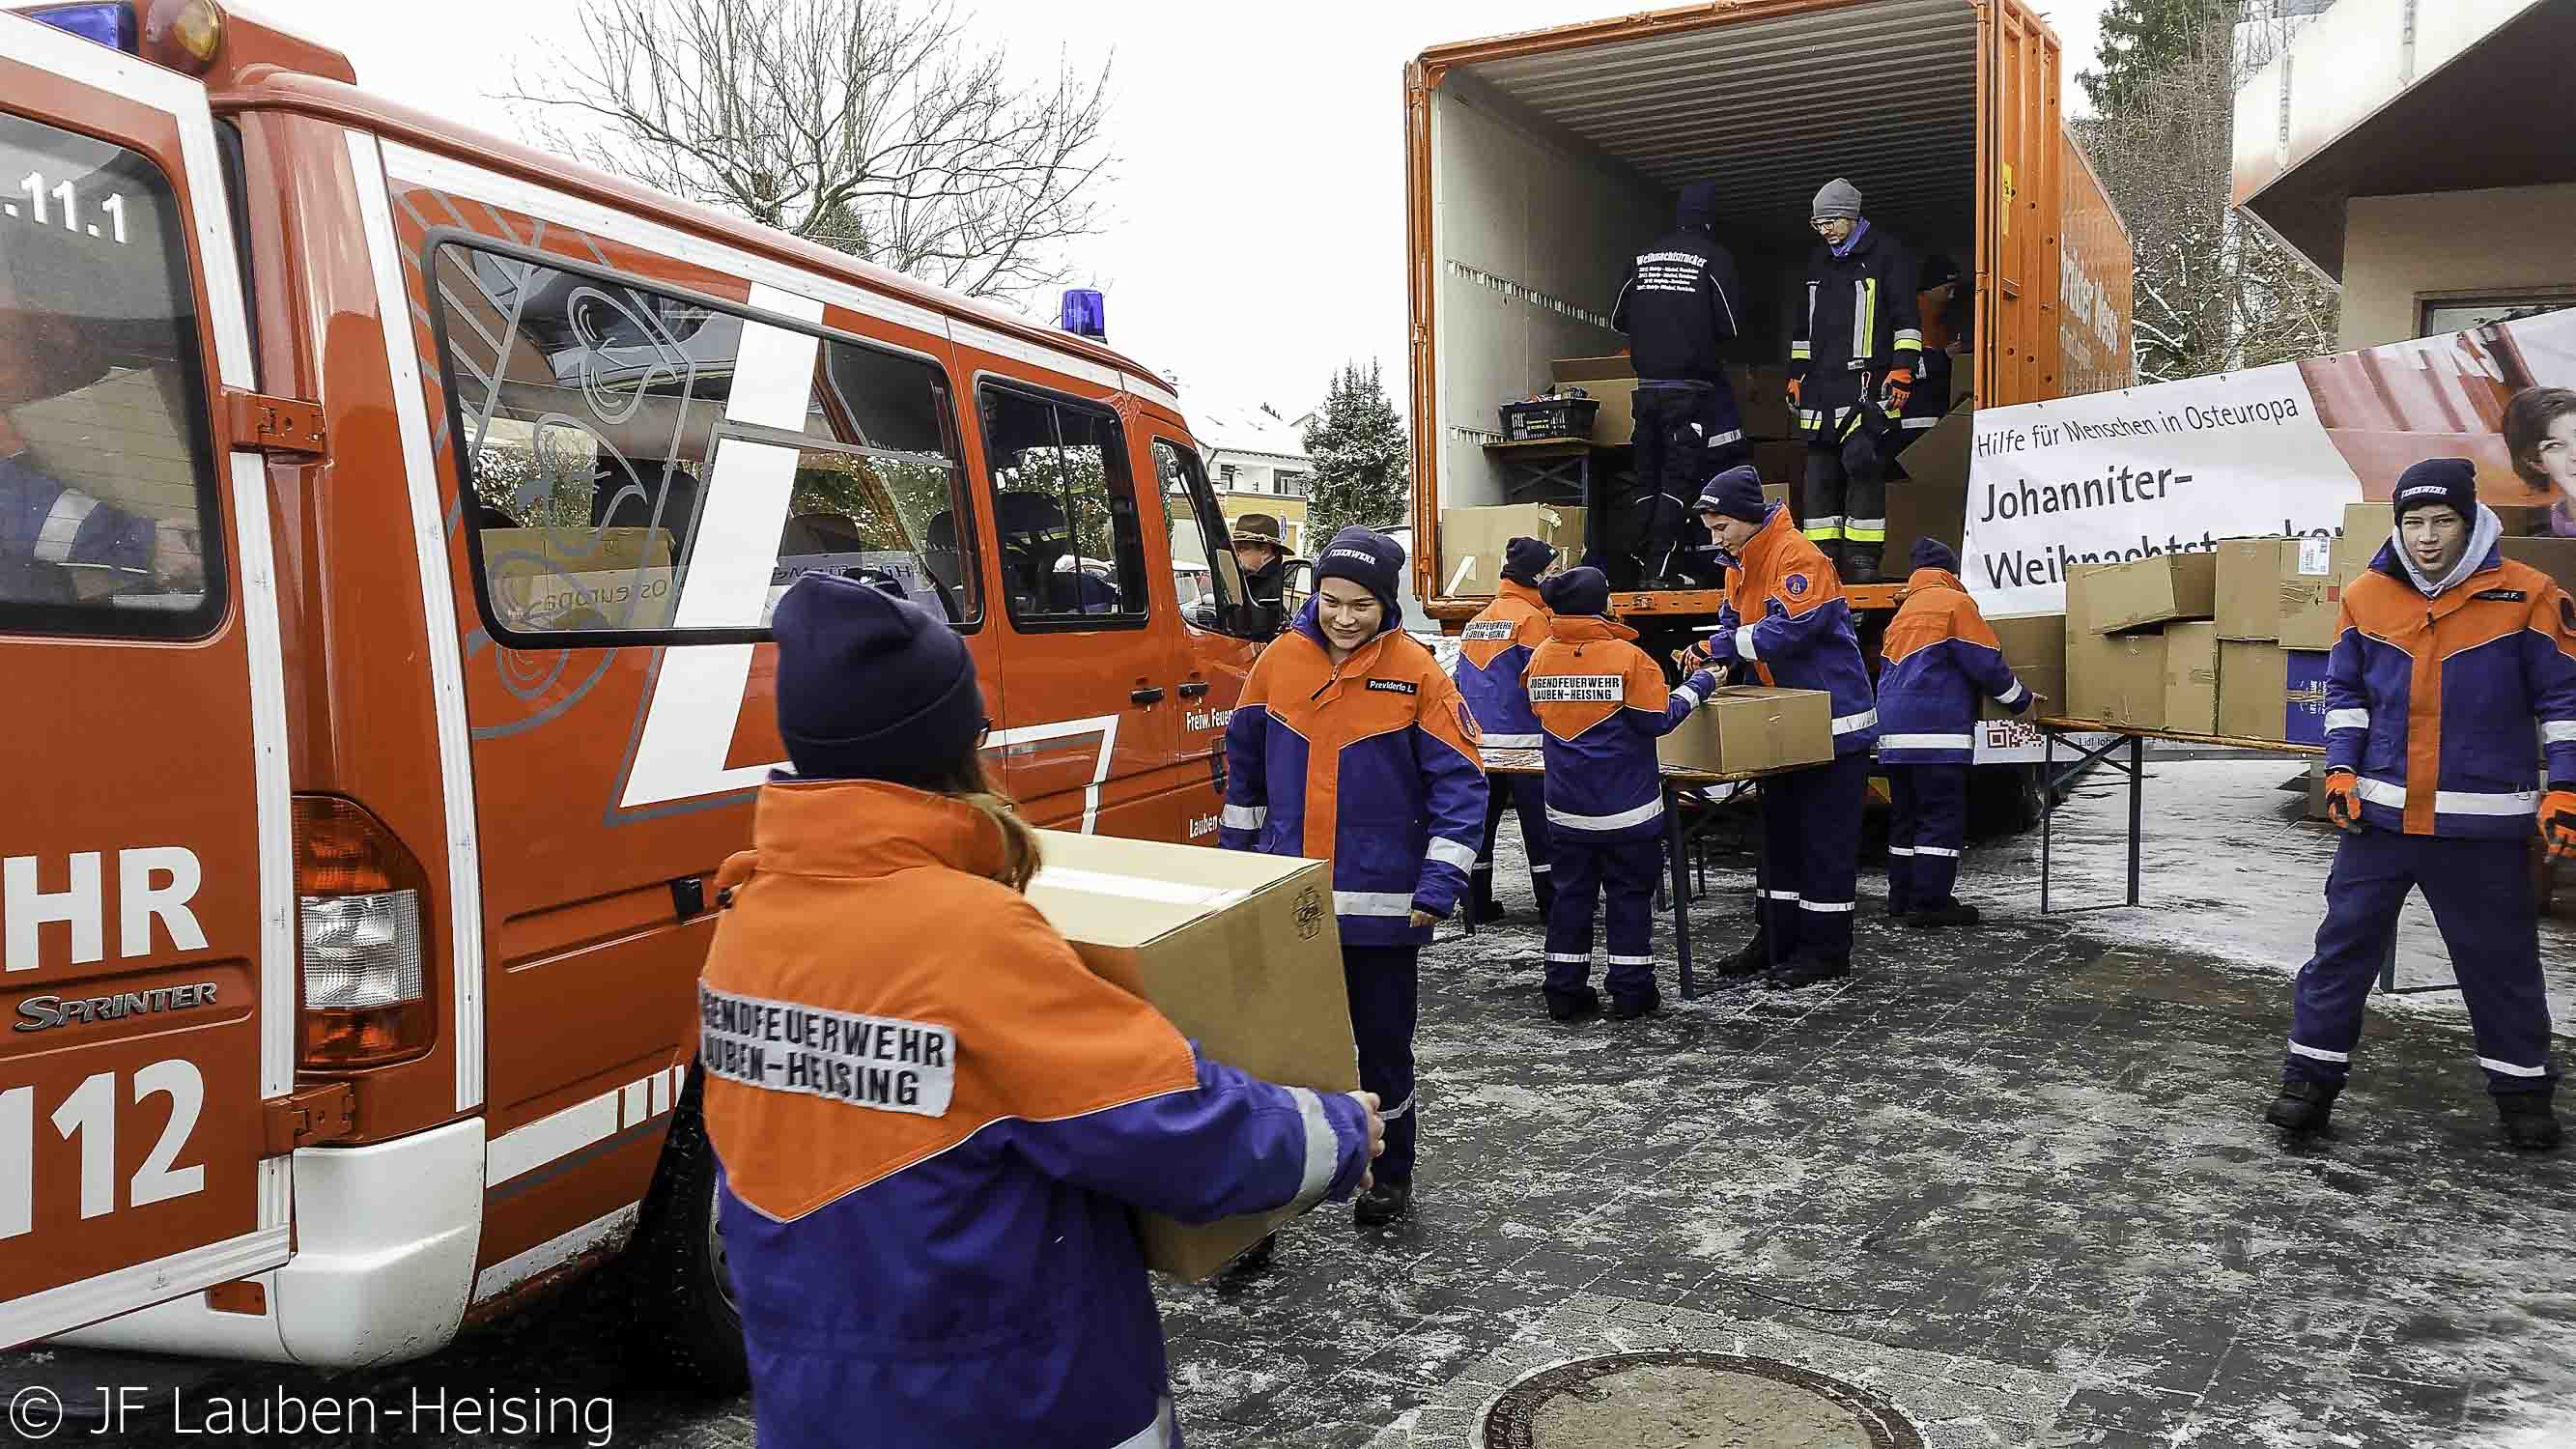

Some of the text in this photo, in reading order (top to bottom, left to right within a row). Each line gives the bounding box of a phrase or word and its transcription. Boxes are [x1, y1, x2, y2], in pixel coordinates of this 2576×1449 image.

[1977, 395, 2299, 457] Hilfe für Menschen in Osteuropa
[1981, 466, 2194, 523] Johanniter-
[1327, 549, 1376, 565] FEUERWEHR
[1530, 677, 1620, 689] JUGENDFEUERWEHR
[1534, 689, 1612, 700] LAUBEN-HEISING
[1189, 812, 1218, 838] Lauben
[4, 846, 209, 972] HR
[14, 981, 217, 1032] SPRINTER
[0, 1059, 205, 1240] 112
